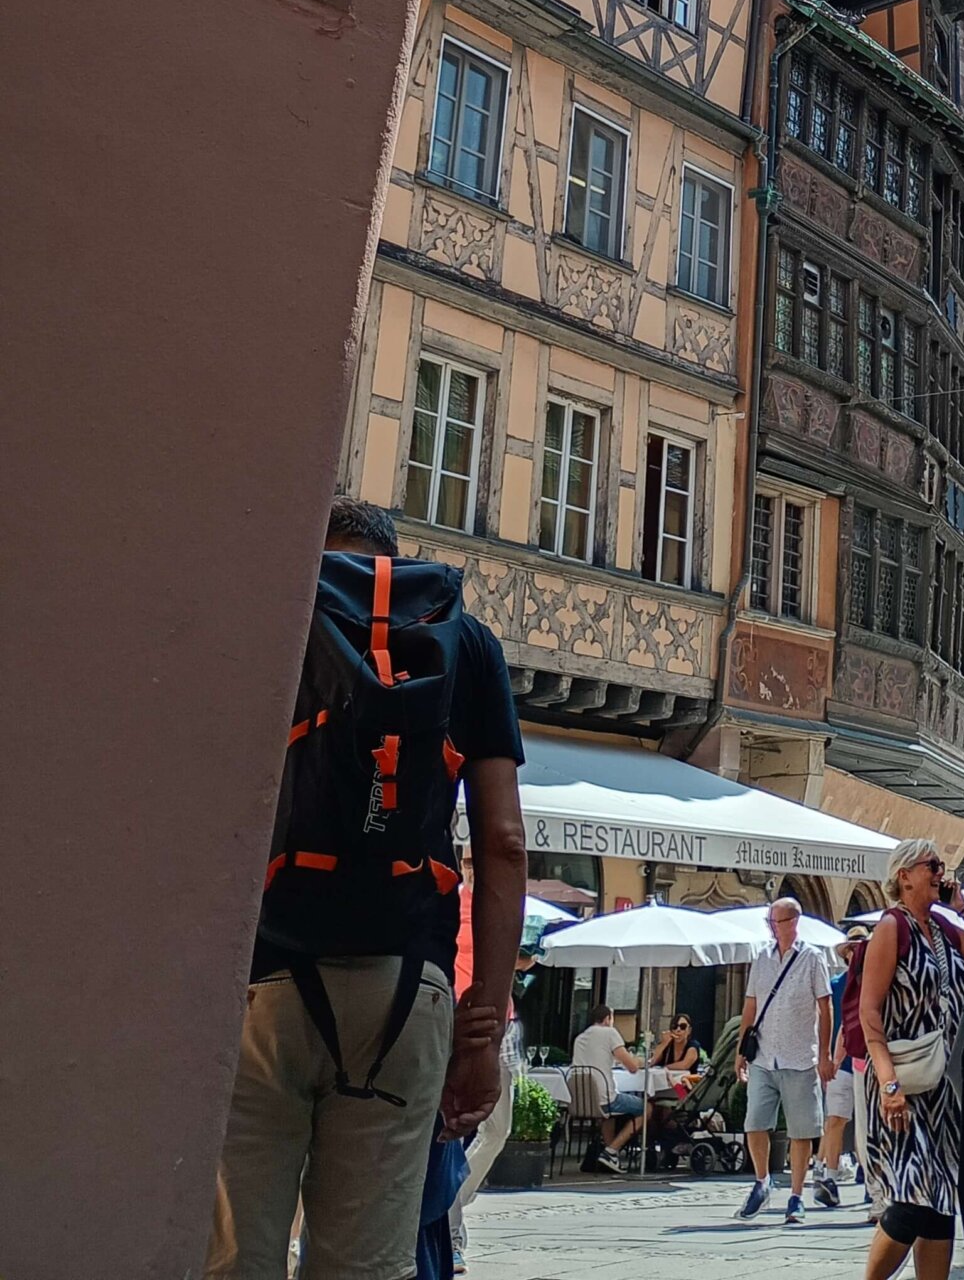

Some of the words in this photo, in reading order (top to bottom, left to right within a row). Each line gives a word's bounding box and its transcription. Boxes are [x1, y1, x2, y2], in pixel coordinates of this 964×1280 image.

[535, 819, 550, 847] &
[563, 822, 707, 862] RESTAURANT
[735, 840, 788, 867] Maison
[792, 846, 866, 875] Kammerzell
